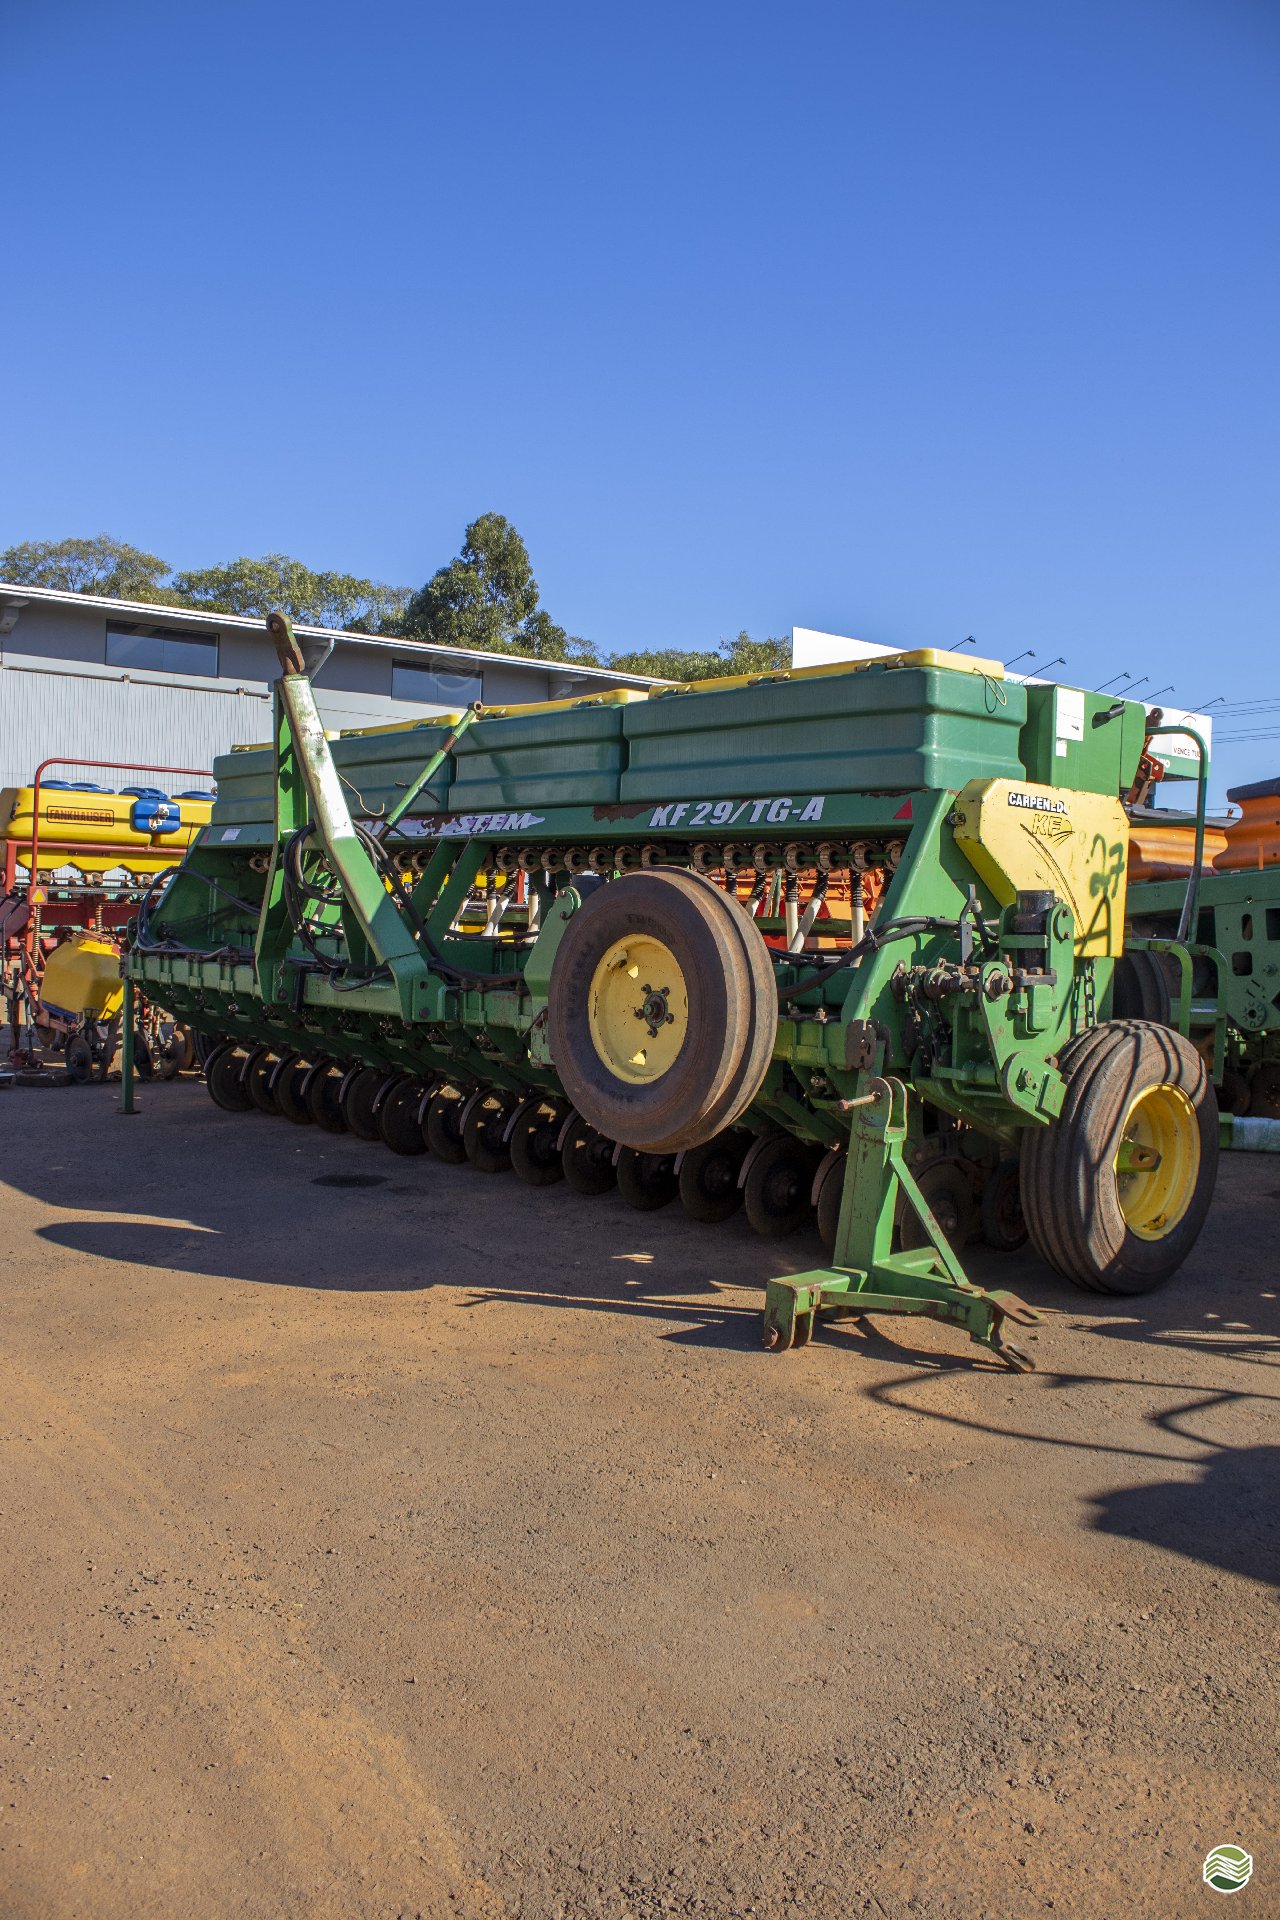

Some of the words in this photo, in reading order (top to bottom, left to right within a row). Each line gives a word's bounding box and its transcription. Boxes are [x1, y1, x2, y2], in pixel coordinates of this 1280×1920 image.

[1173, 747, 1191, 757] VENCE
[50, 809, 112, 823] FANKHAUSER
[649, 803, 690, 827] KF
[688, 797, 825, 826] 29/TG-A
